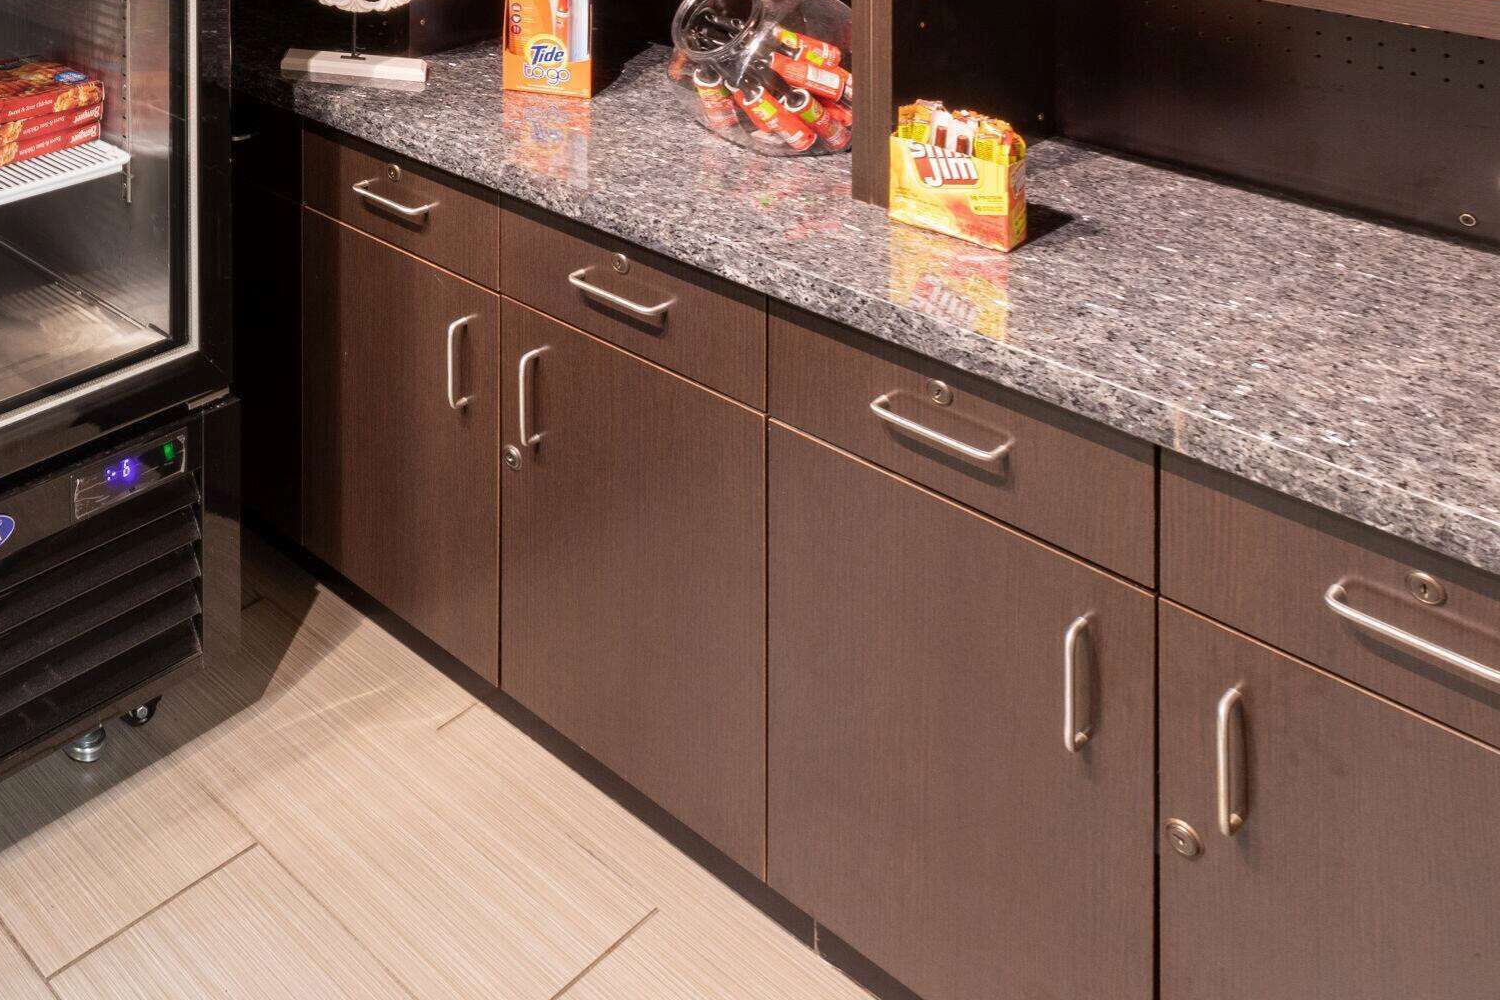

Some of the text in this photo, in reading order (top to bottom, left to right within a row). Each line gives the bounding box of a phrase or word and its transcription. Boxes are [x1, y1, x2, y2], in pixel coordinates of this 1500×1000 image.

[530, 44, 565, 65] Tide
[524, 64, 570, 85] to go
